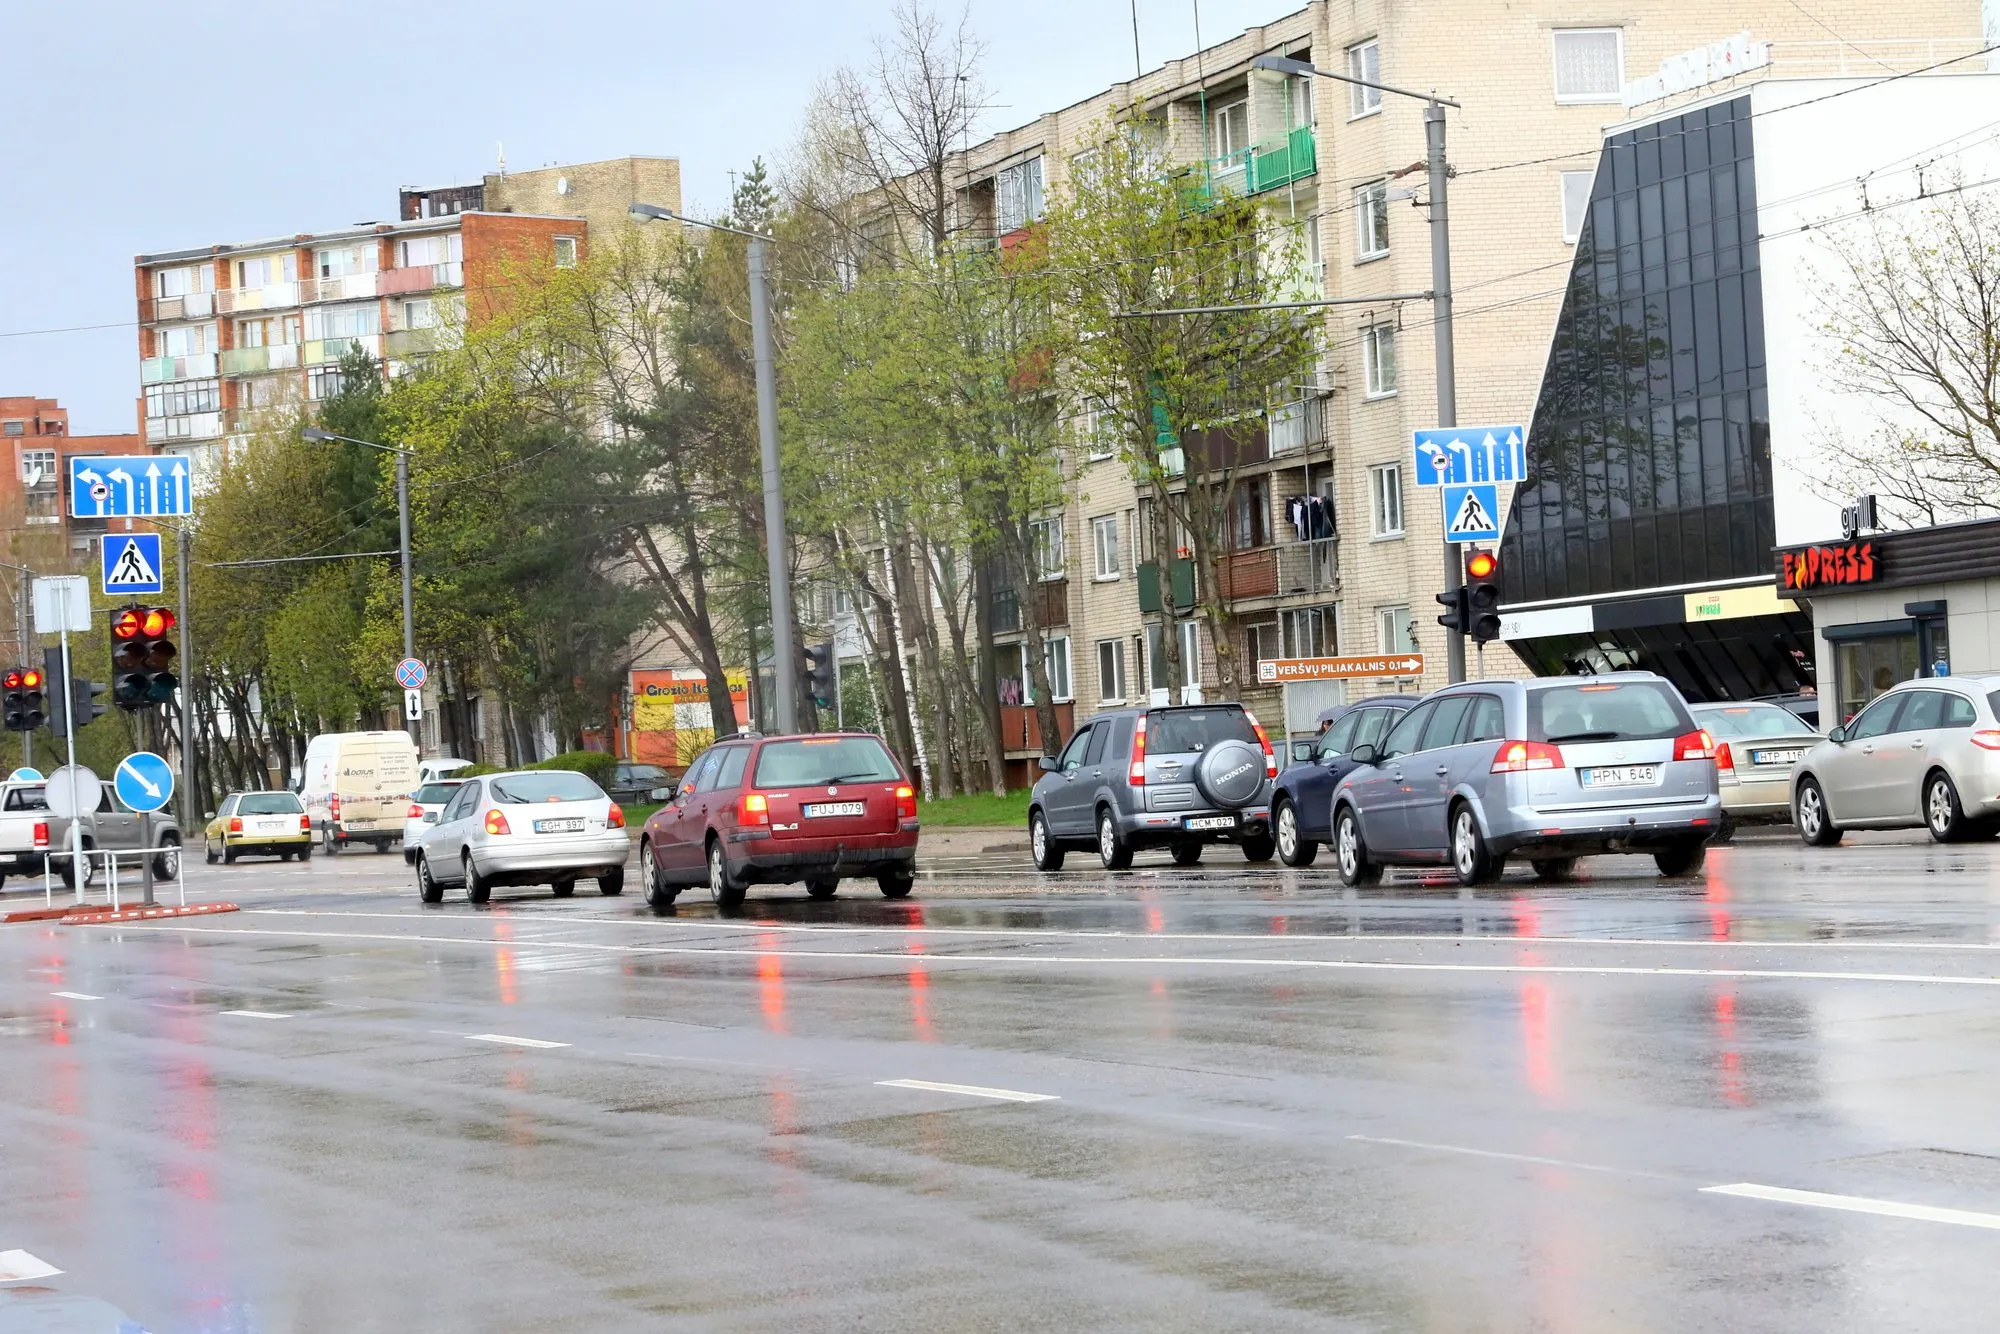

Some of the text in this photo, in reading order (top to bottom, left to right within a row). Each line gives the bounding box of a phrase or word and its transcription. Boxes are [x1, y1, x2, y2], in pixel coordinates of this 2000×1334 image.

[1841, 495, 1873, 541] grill
[1783, 542, 1874, 590] EXPRESS
[1277, 663, 1319, 676] VERŠVŲ
[1321, 661, 1386, 673] PILIAKALNIS
[1760, 751, 1780, 761] HTP
[1215, 762, 1254, 786] HONDA
[1592, 767, 1653, 783] HPN 646
[810, 803, 861, 816] FUJ 079
[540, 820, 582, 831] EGH 997
[1191, 817, 1233, 829] HCM 027
